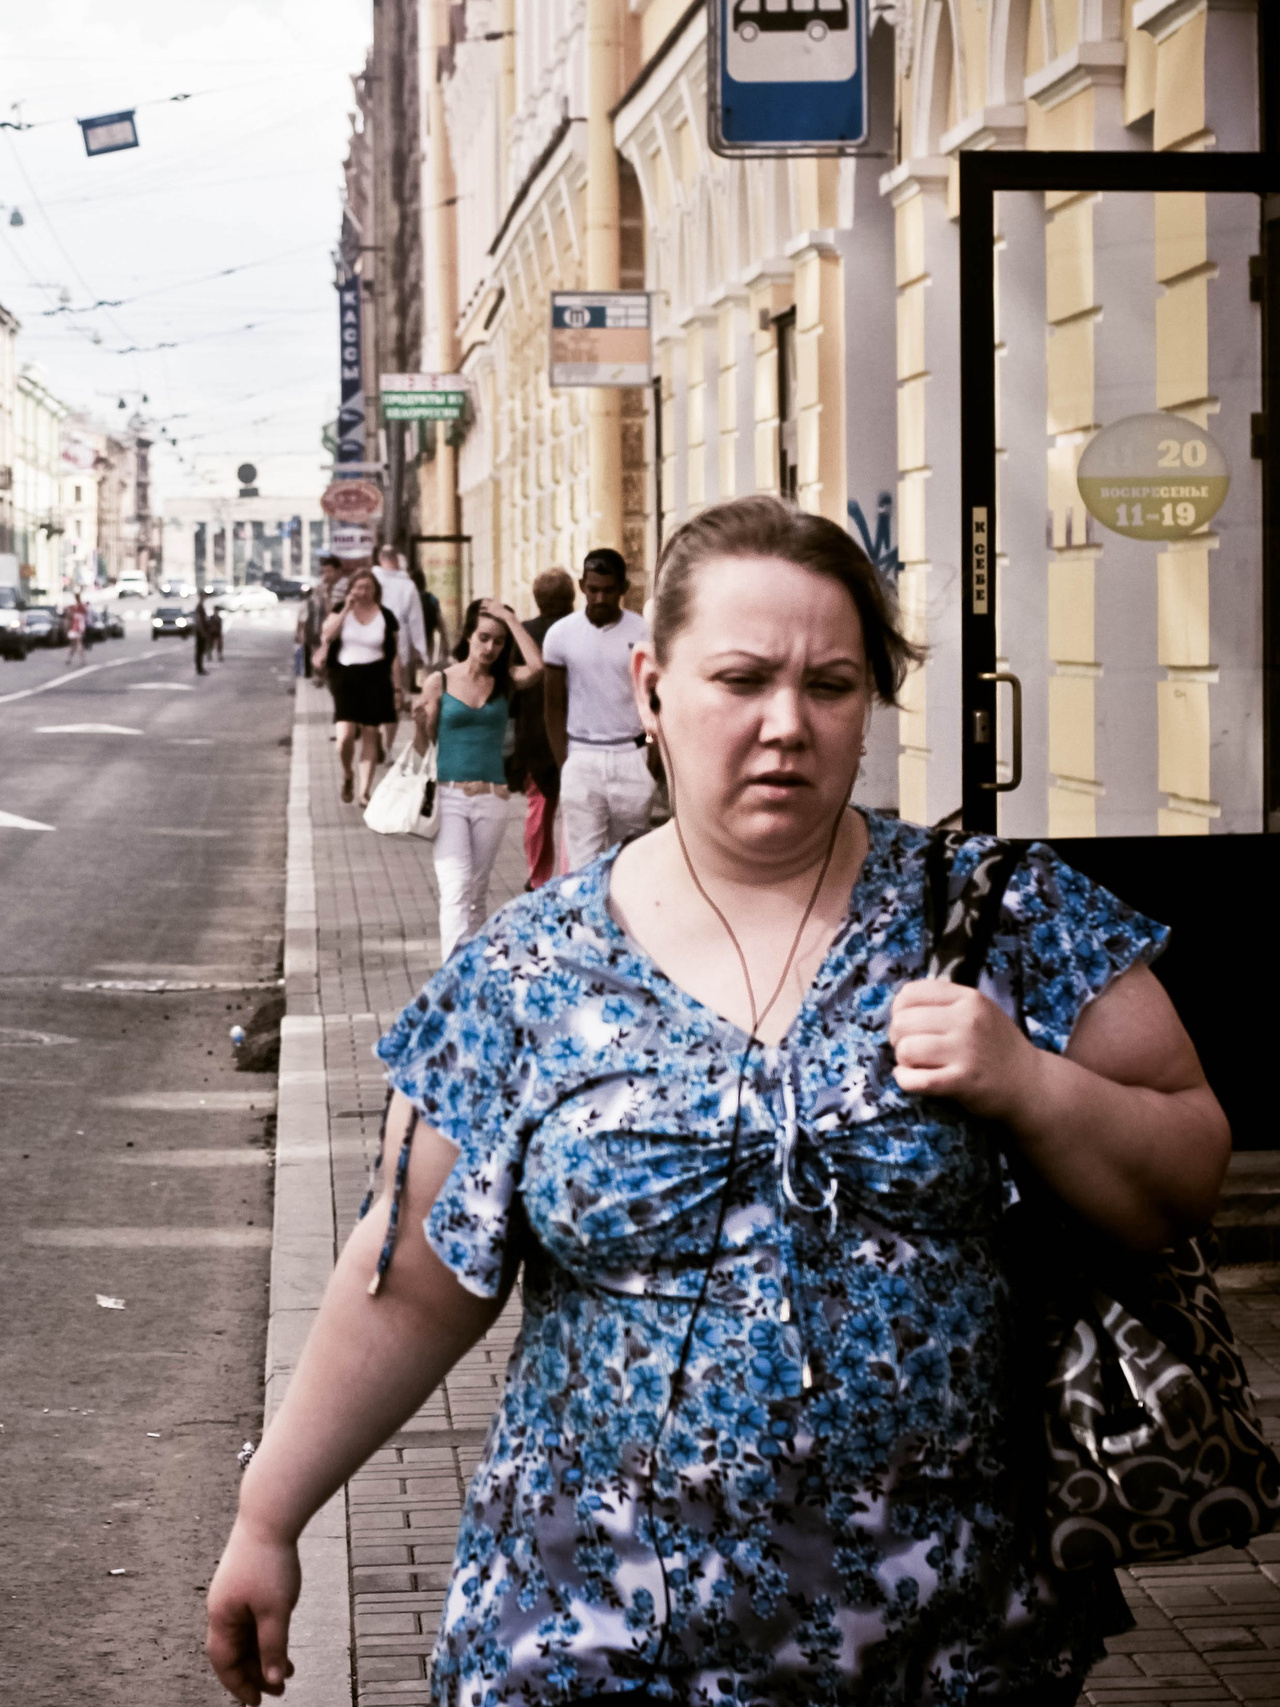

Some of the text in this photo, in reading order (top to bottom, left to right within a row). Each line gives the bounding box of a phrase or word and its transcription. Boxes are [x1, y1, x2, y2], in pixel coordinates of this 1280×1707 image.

[1101, 486, 1209, 498] ВОСКРЕСЕНЬЕ
[974, 521, 985, 600] К СЕБЕ
